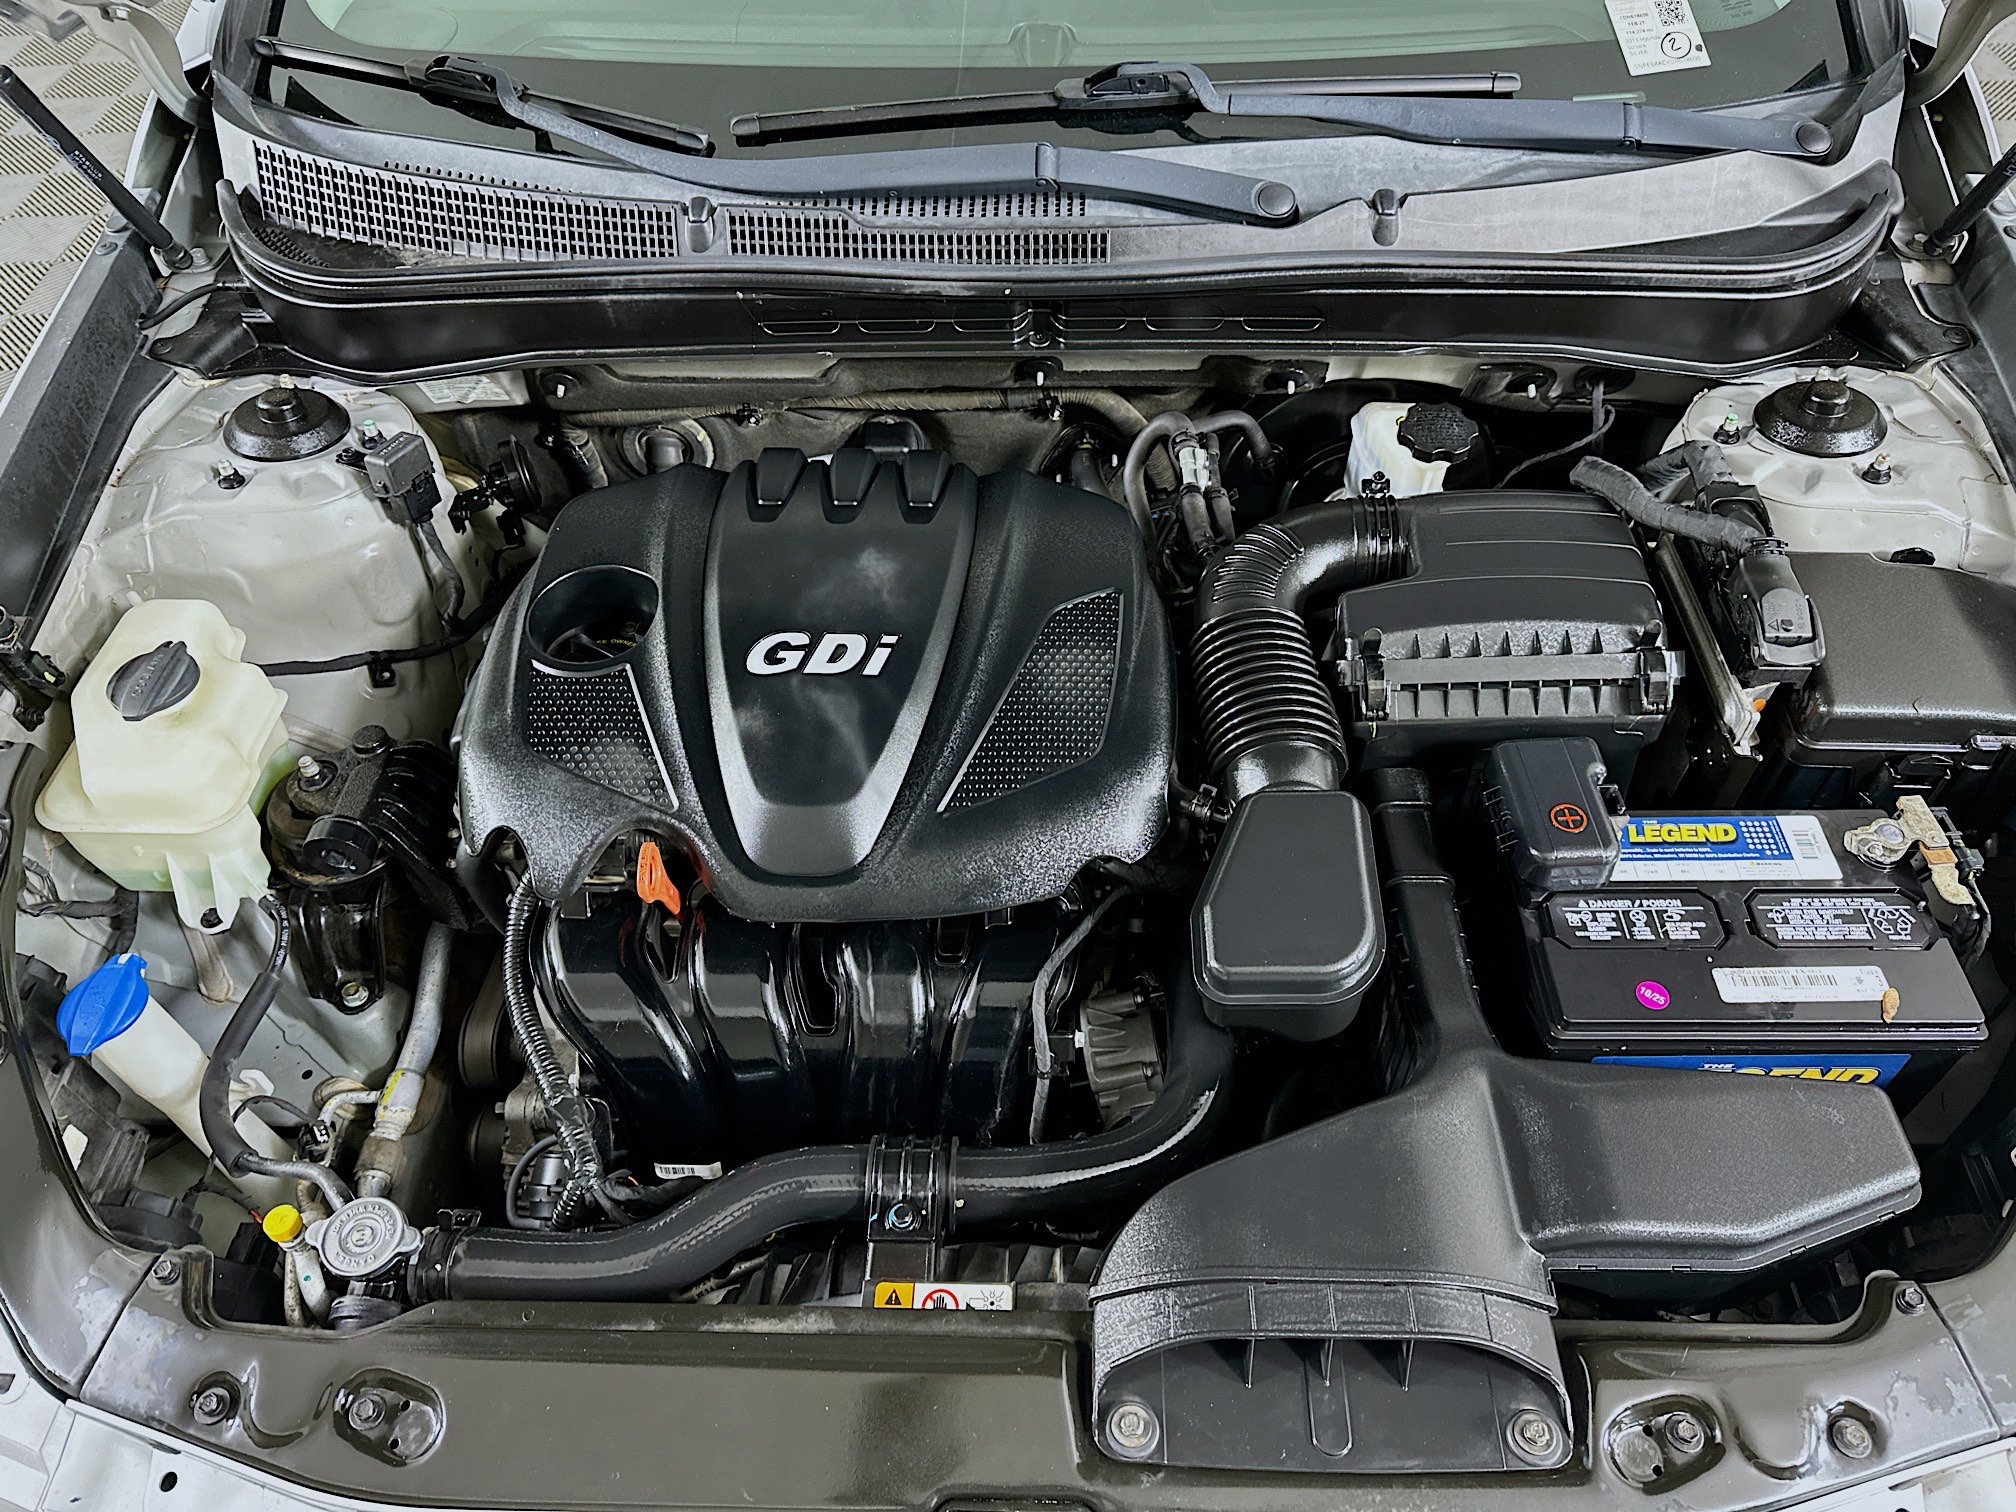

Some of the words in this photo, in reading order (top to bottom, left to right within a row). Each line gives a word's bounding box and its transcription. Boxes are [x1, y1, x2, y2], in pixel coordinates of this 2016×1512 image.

[1669, 37, 1682, 51] 2
[74, 150, 103, 178] STABILUS
[745, 630, 902, 676] GDi
[1627, 823, 1738, 844] LEGEND
[1588, 900, 1633, 908] DANGER
[1642, 899, 1683, 907] POISON
[1640, 986, 1666, 1005] 10/25
